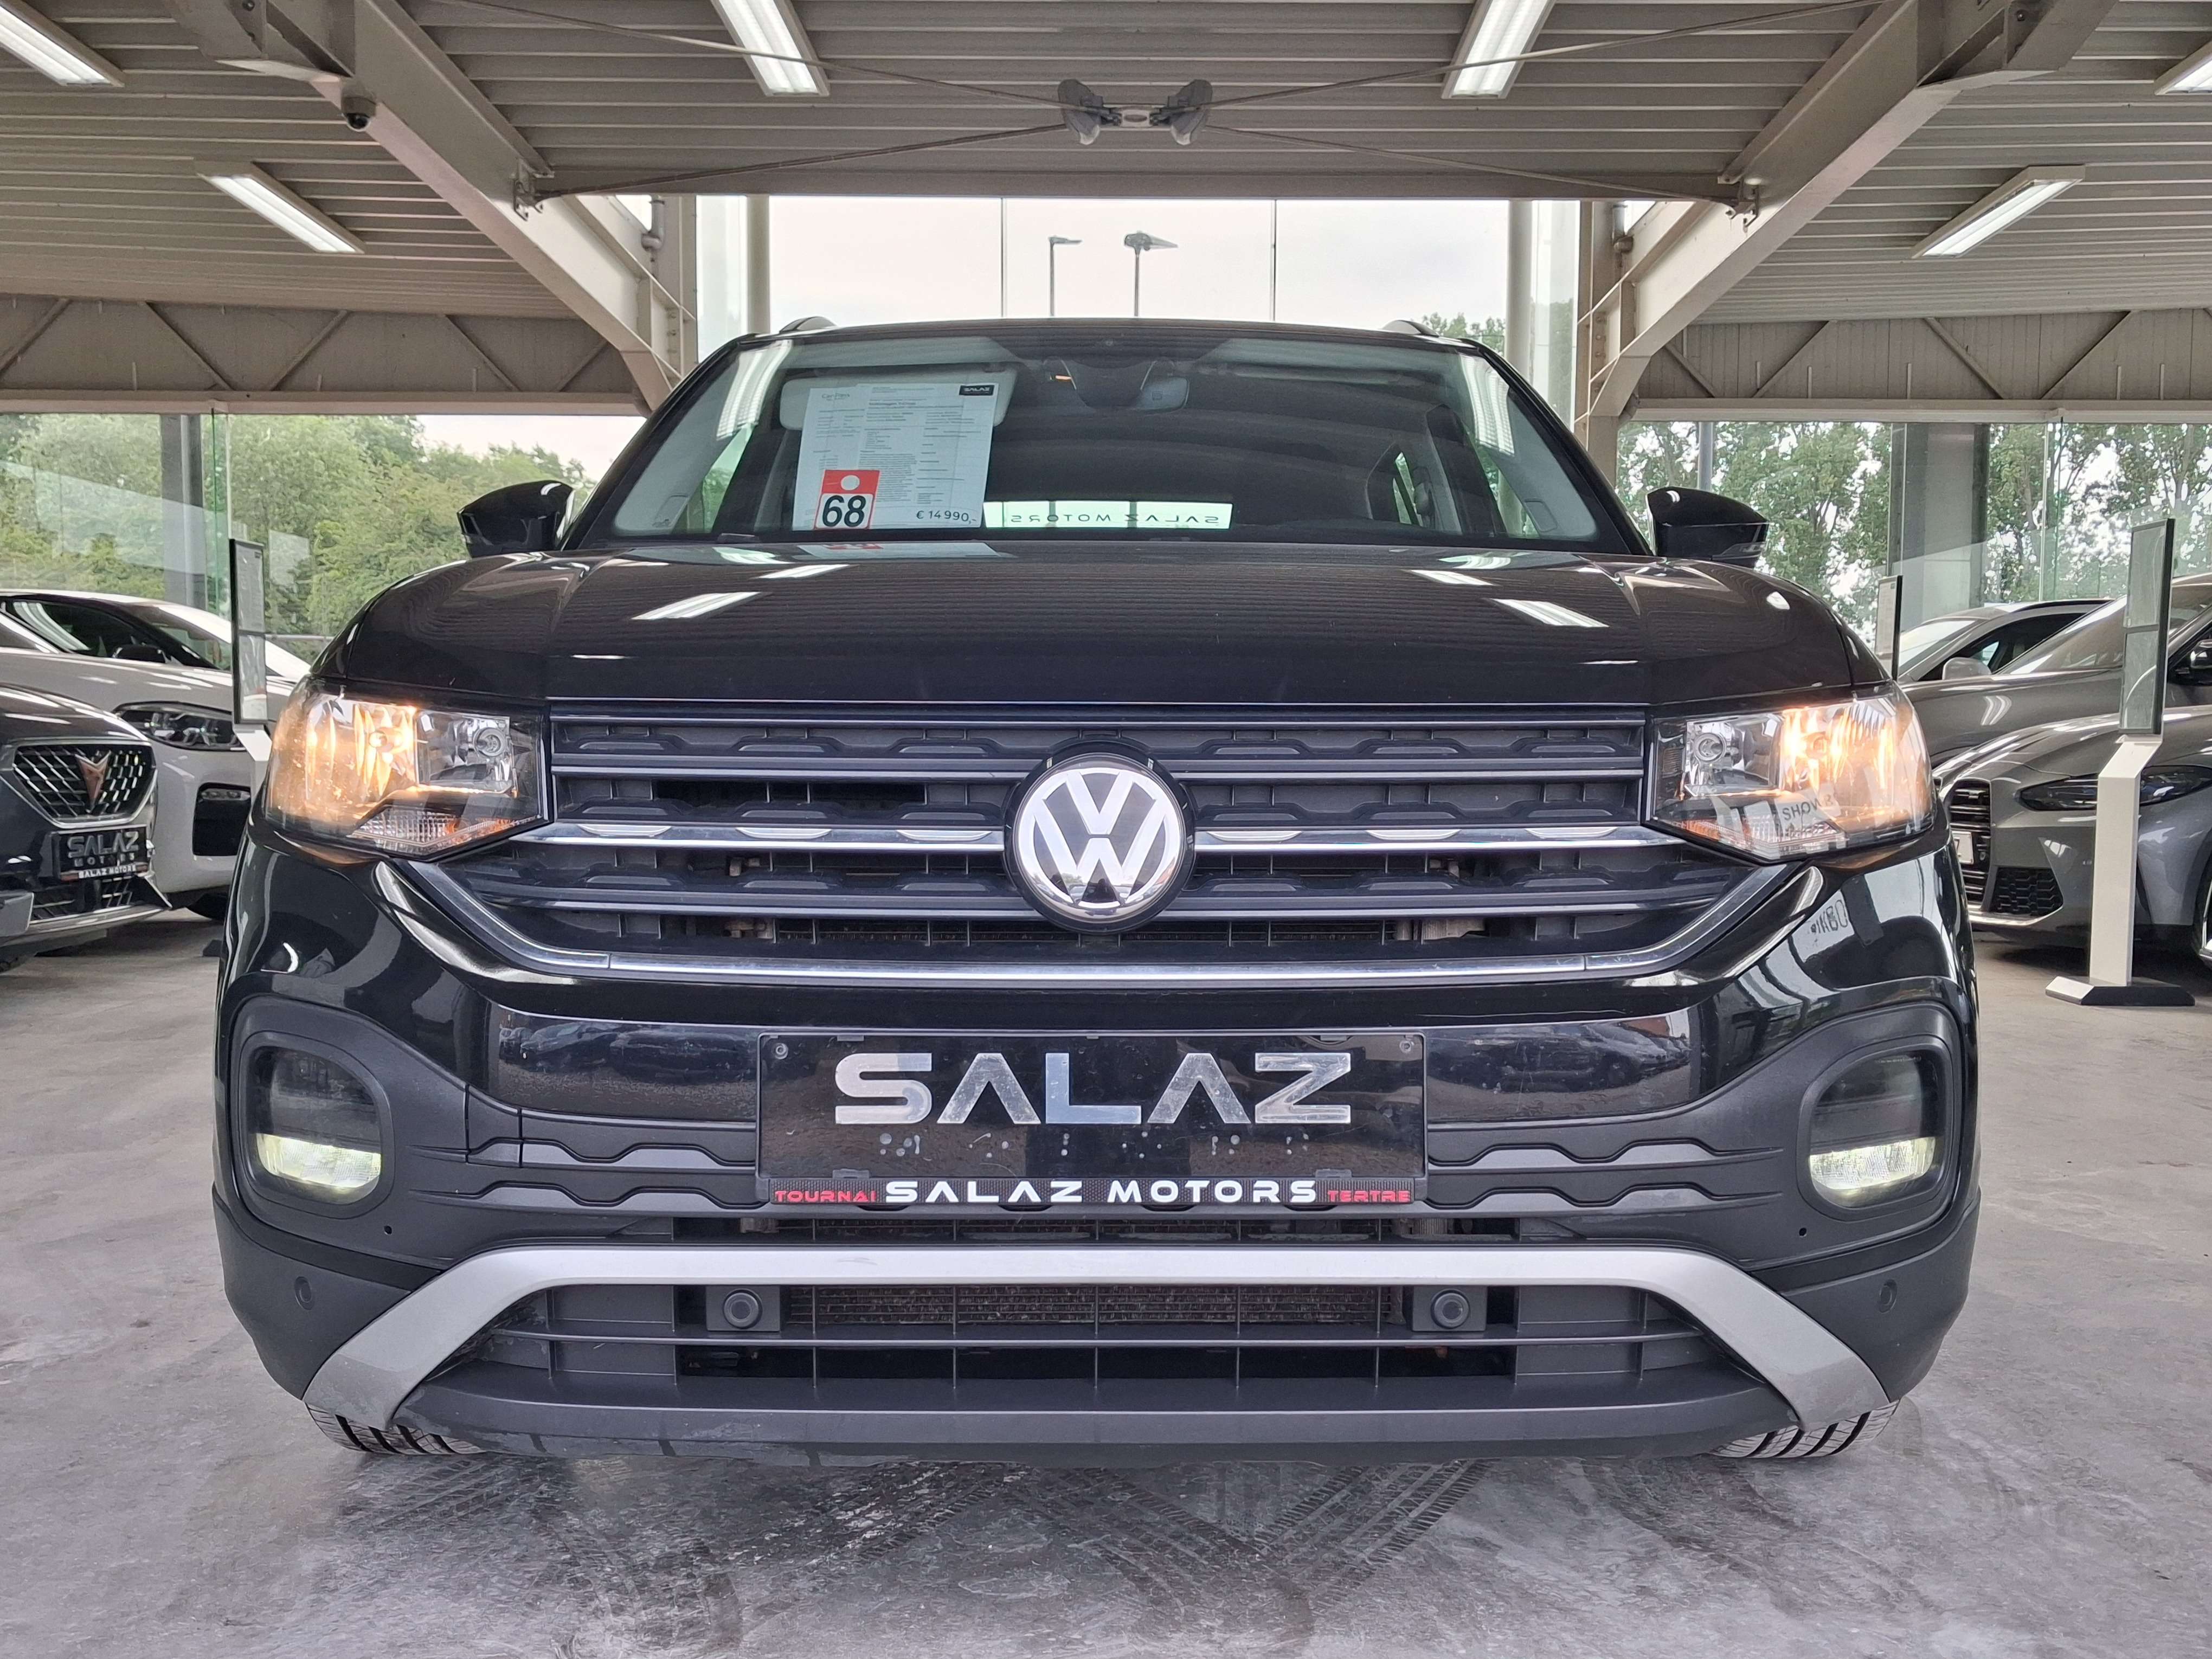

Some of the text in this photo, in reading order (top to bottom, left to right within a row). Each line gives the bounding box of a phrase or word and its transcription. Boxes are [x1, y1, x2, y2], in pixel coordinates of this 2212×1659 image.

[822, 495, 866, 527] 68
[67, 831, 139, 858] SALAZ
[835, 1052, 1351, 1125] SALAZ
[775, 1180, 1410, 1203] TOURNAI SALAZ MOTORS TERTRE
